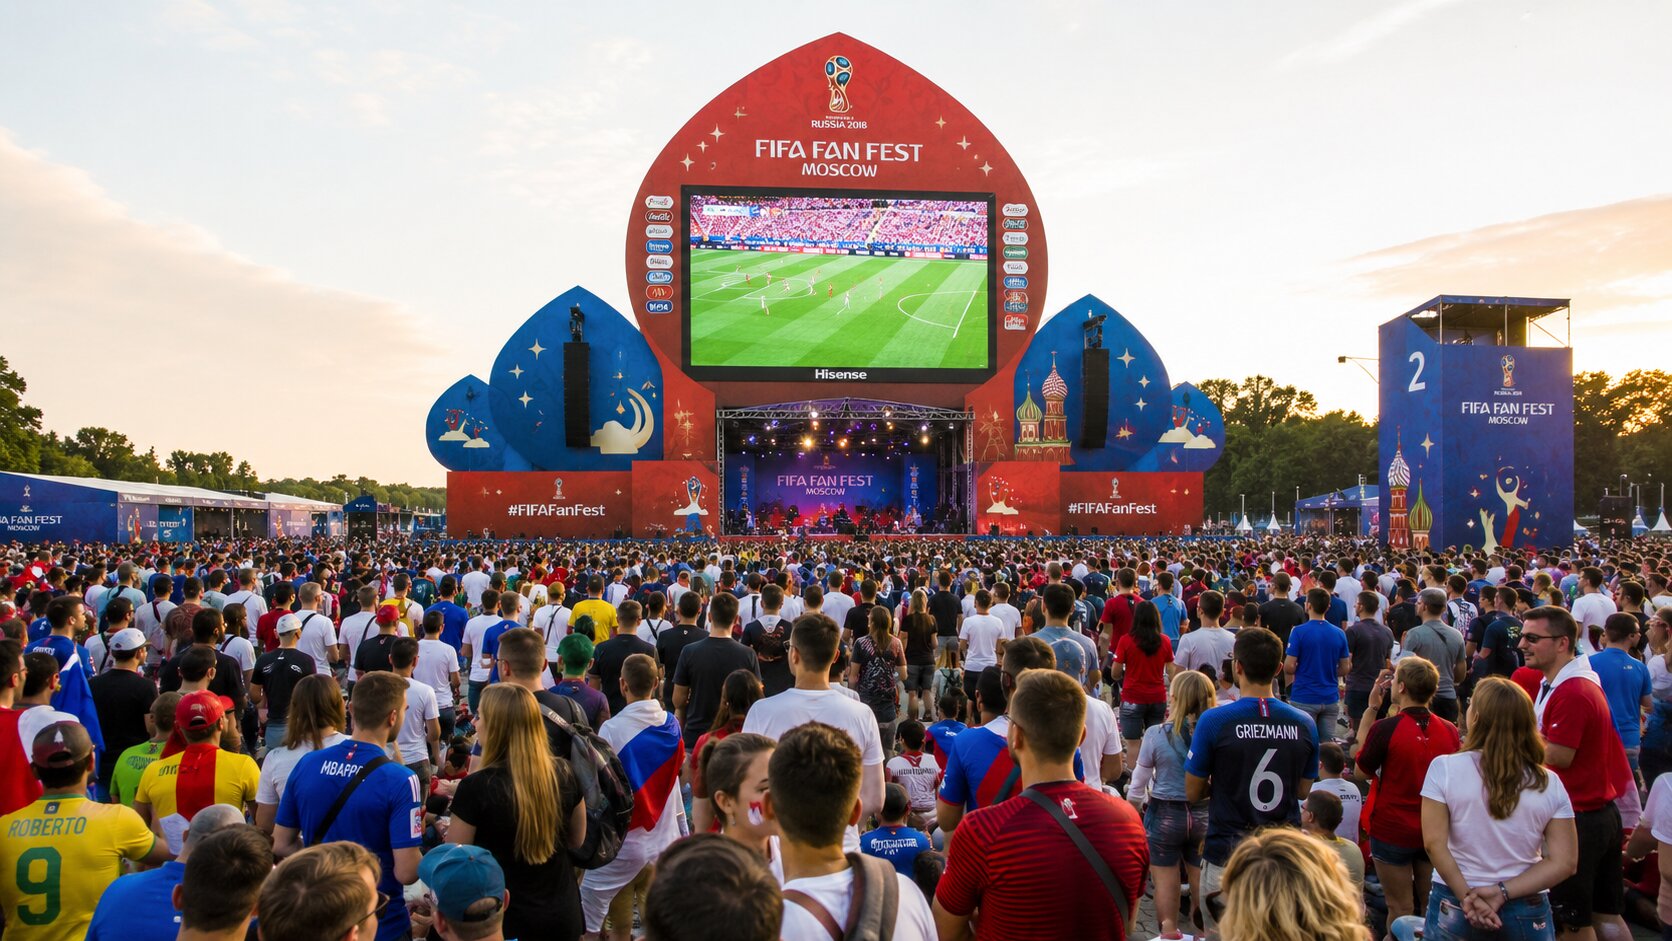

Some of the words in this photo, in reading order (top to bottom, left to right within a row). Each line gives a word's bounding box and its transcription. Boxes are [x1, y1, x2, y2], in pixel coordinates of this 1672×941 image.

[811, 119, 846, 129] RUSSIA
[847, 120, 868, 129] 2018
[755, 139, 807, 159] FIFA
[812, 140, 860, 161] FAN
[866, 142, 924, 162] FEST
[801, 162, 878, 177] MOSCOW
[815, 368, 868, 380] Hisense
[1408, 350, 1426, 393] 2
[1461, 401, 1491, 414] FIFA
[1493, 402, 1520, 415] FAN
[1522, 403, 1555, 416] FEST
[1488, 416, 1529, 425] MOSCOW
[777, 475, 807, 487] FIFA
[810, 475, 837, 487] FAN
[840, 475, 874, 487] FEST
[805, 487, 846, 496] MOSCOW
[508, 503, 606, 516] #FIFAFanFest
[1068, 502, 1157, 515] #FIFAFanFest
[11, 515, 33, 525] FAN
[1235, 724, 1298, 740] GRIEZMANN
[1249, 748, 1284, 812] 6
[8, 816, 87, 838] ROBERTO
[16, 846, 62, 926] 9
